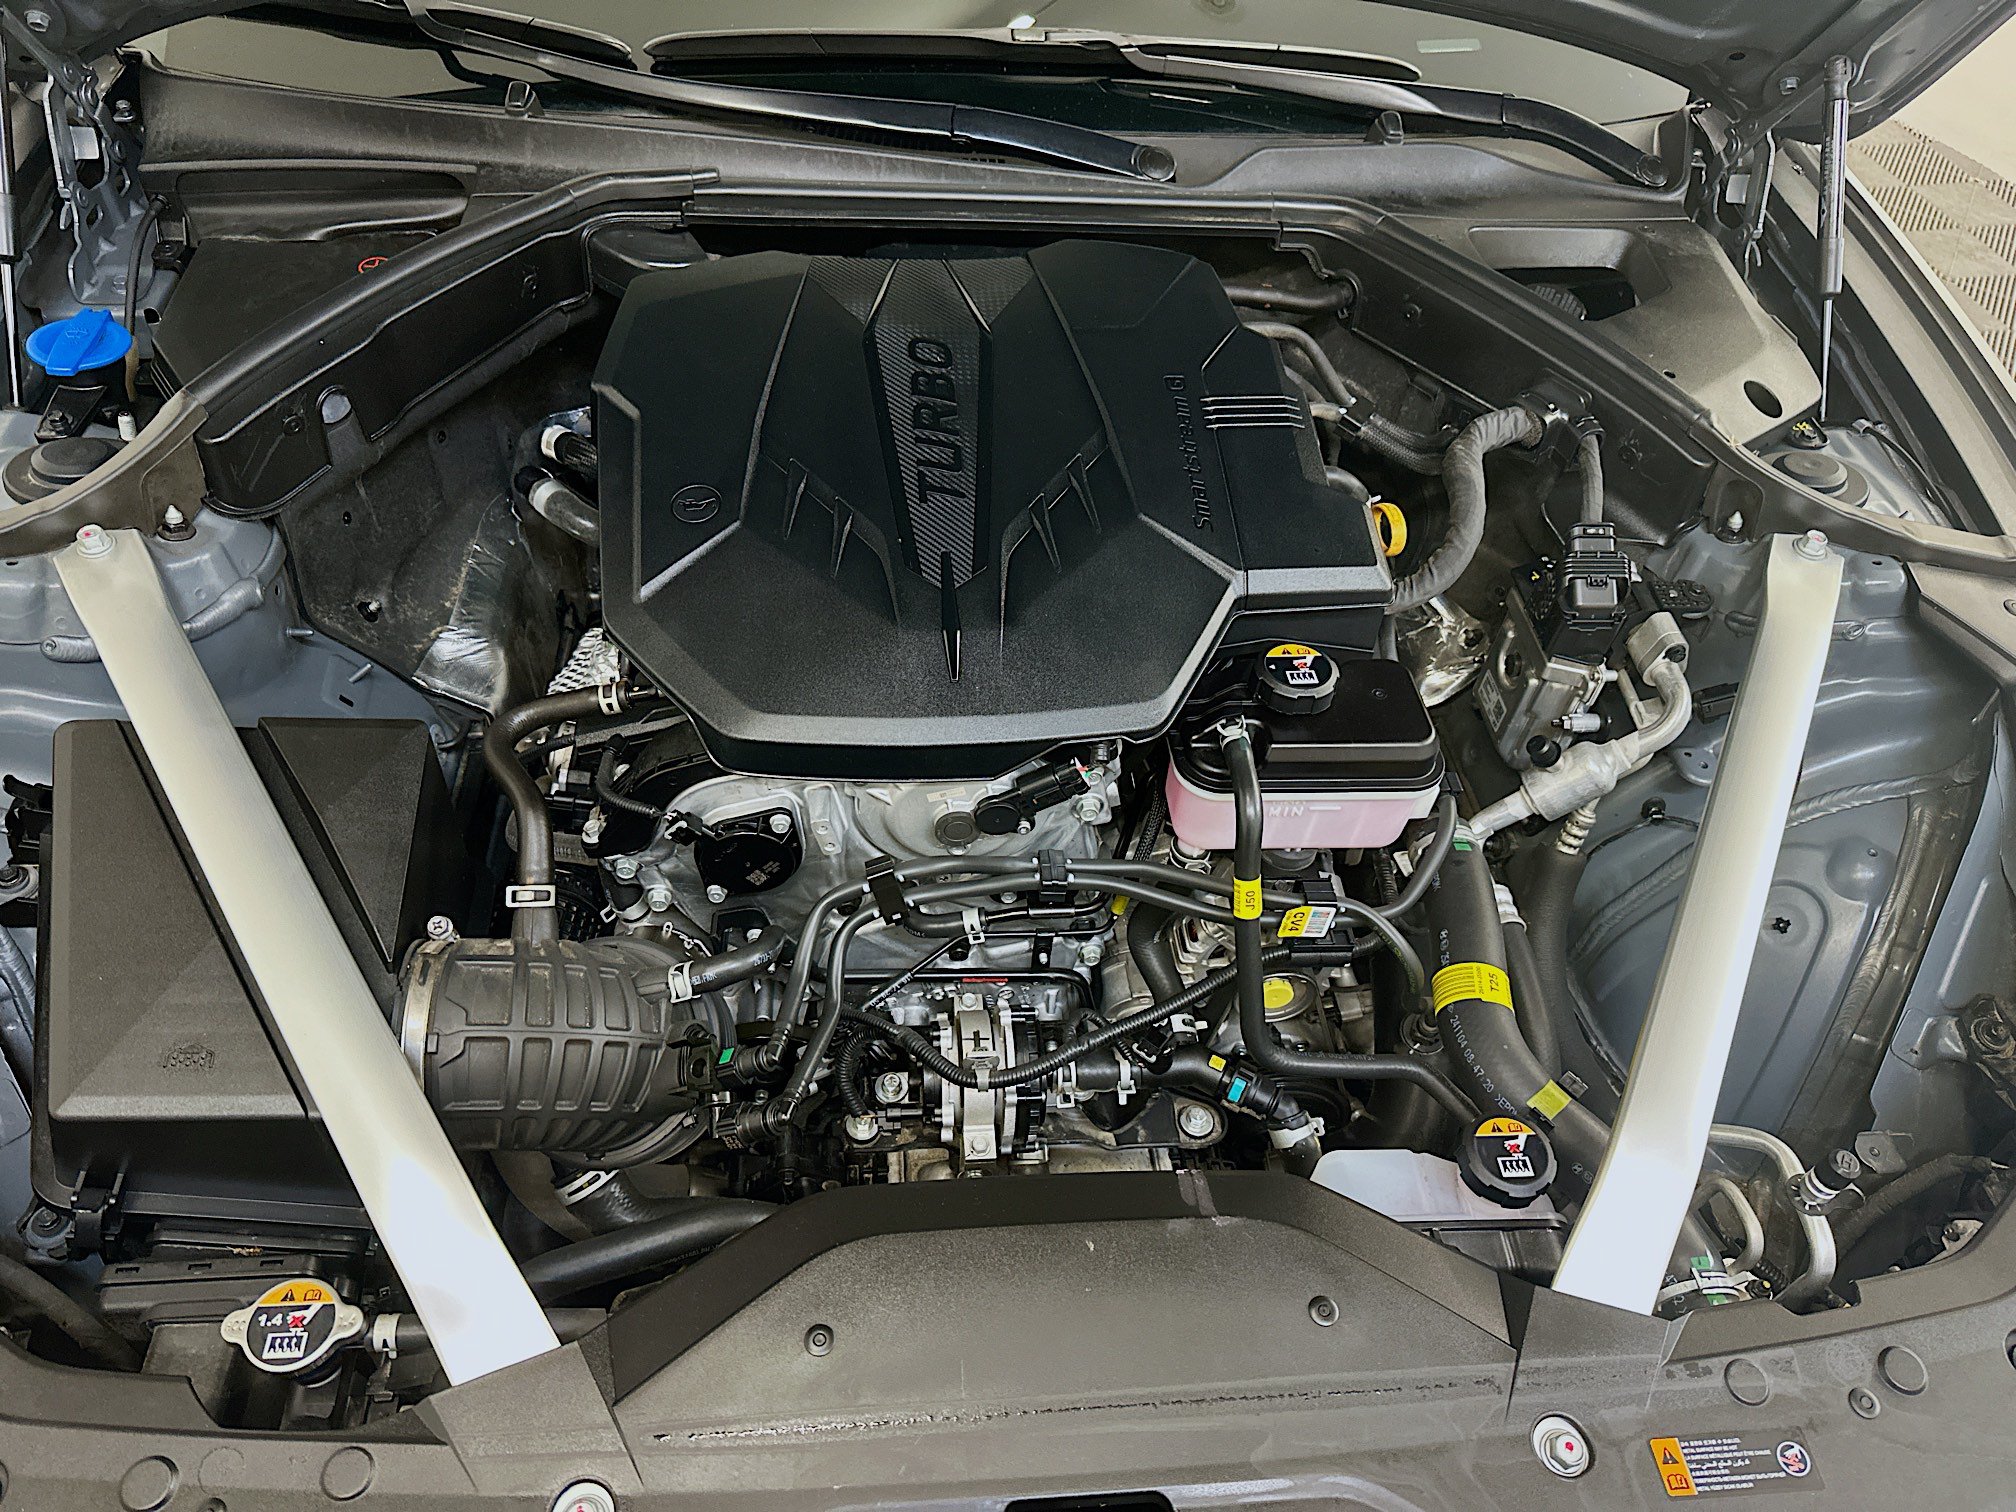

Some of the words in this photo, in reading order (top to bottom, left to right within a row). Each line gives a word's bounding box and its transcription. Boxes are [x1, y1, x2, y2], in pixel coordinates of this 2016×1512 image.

[1163, 374, 1185, 390] G
[908, 337, 969, 505] TURBO
[1172, 396, 1214, 533] Smartstream
[1268, 805, 1305, 817] MIN
[1245, 890, 1256, 910] J50
[1287, 911, 1305, 932] CV4
[1488, 972, 1499, 992] T25
[1450, 1015, 1468, 1048] 241104
[257, 1312, 284, 1328] 1.4
